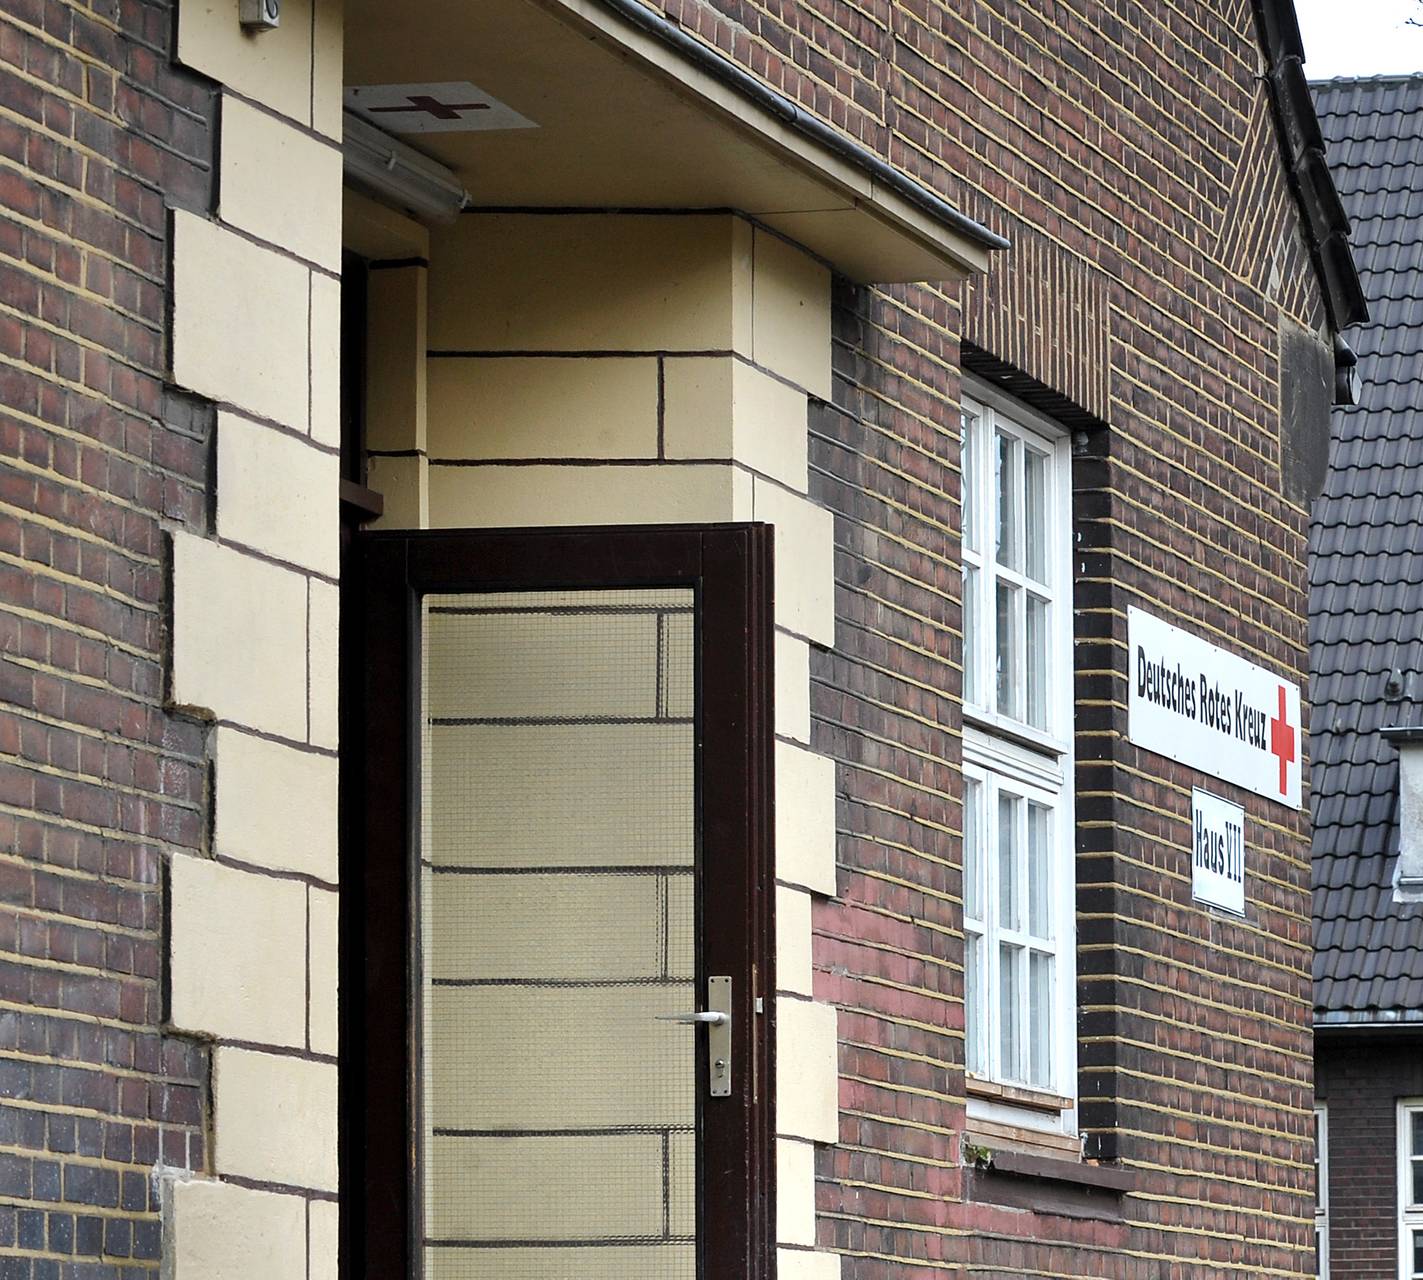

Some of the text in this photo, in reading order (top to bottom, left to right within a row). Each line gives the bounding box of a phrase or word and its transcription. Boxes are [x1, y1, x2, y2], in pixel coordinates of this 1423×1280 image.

[1138, 645, 1266, 751] Deutsches Rotes Kreuz
[1196, 809, 1224, 876] Haus
